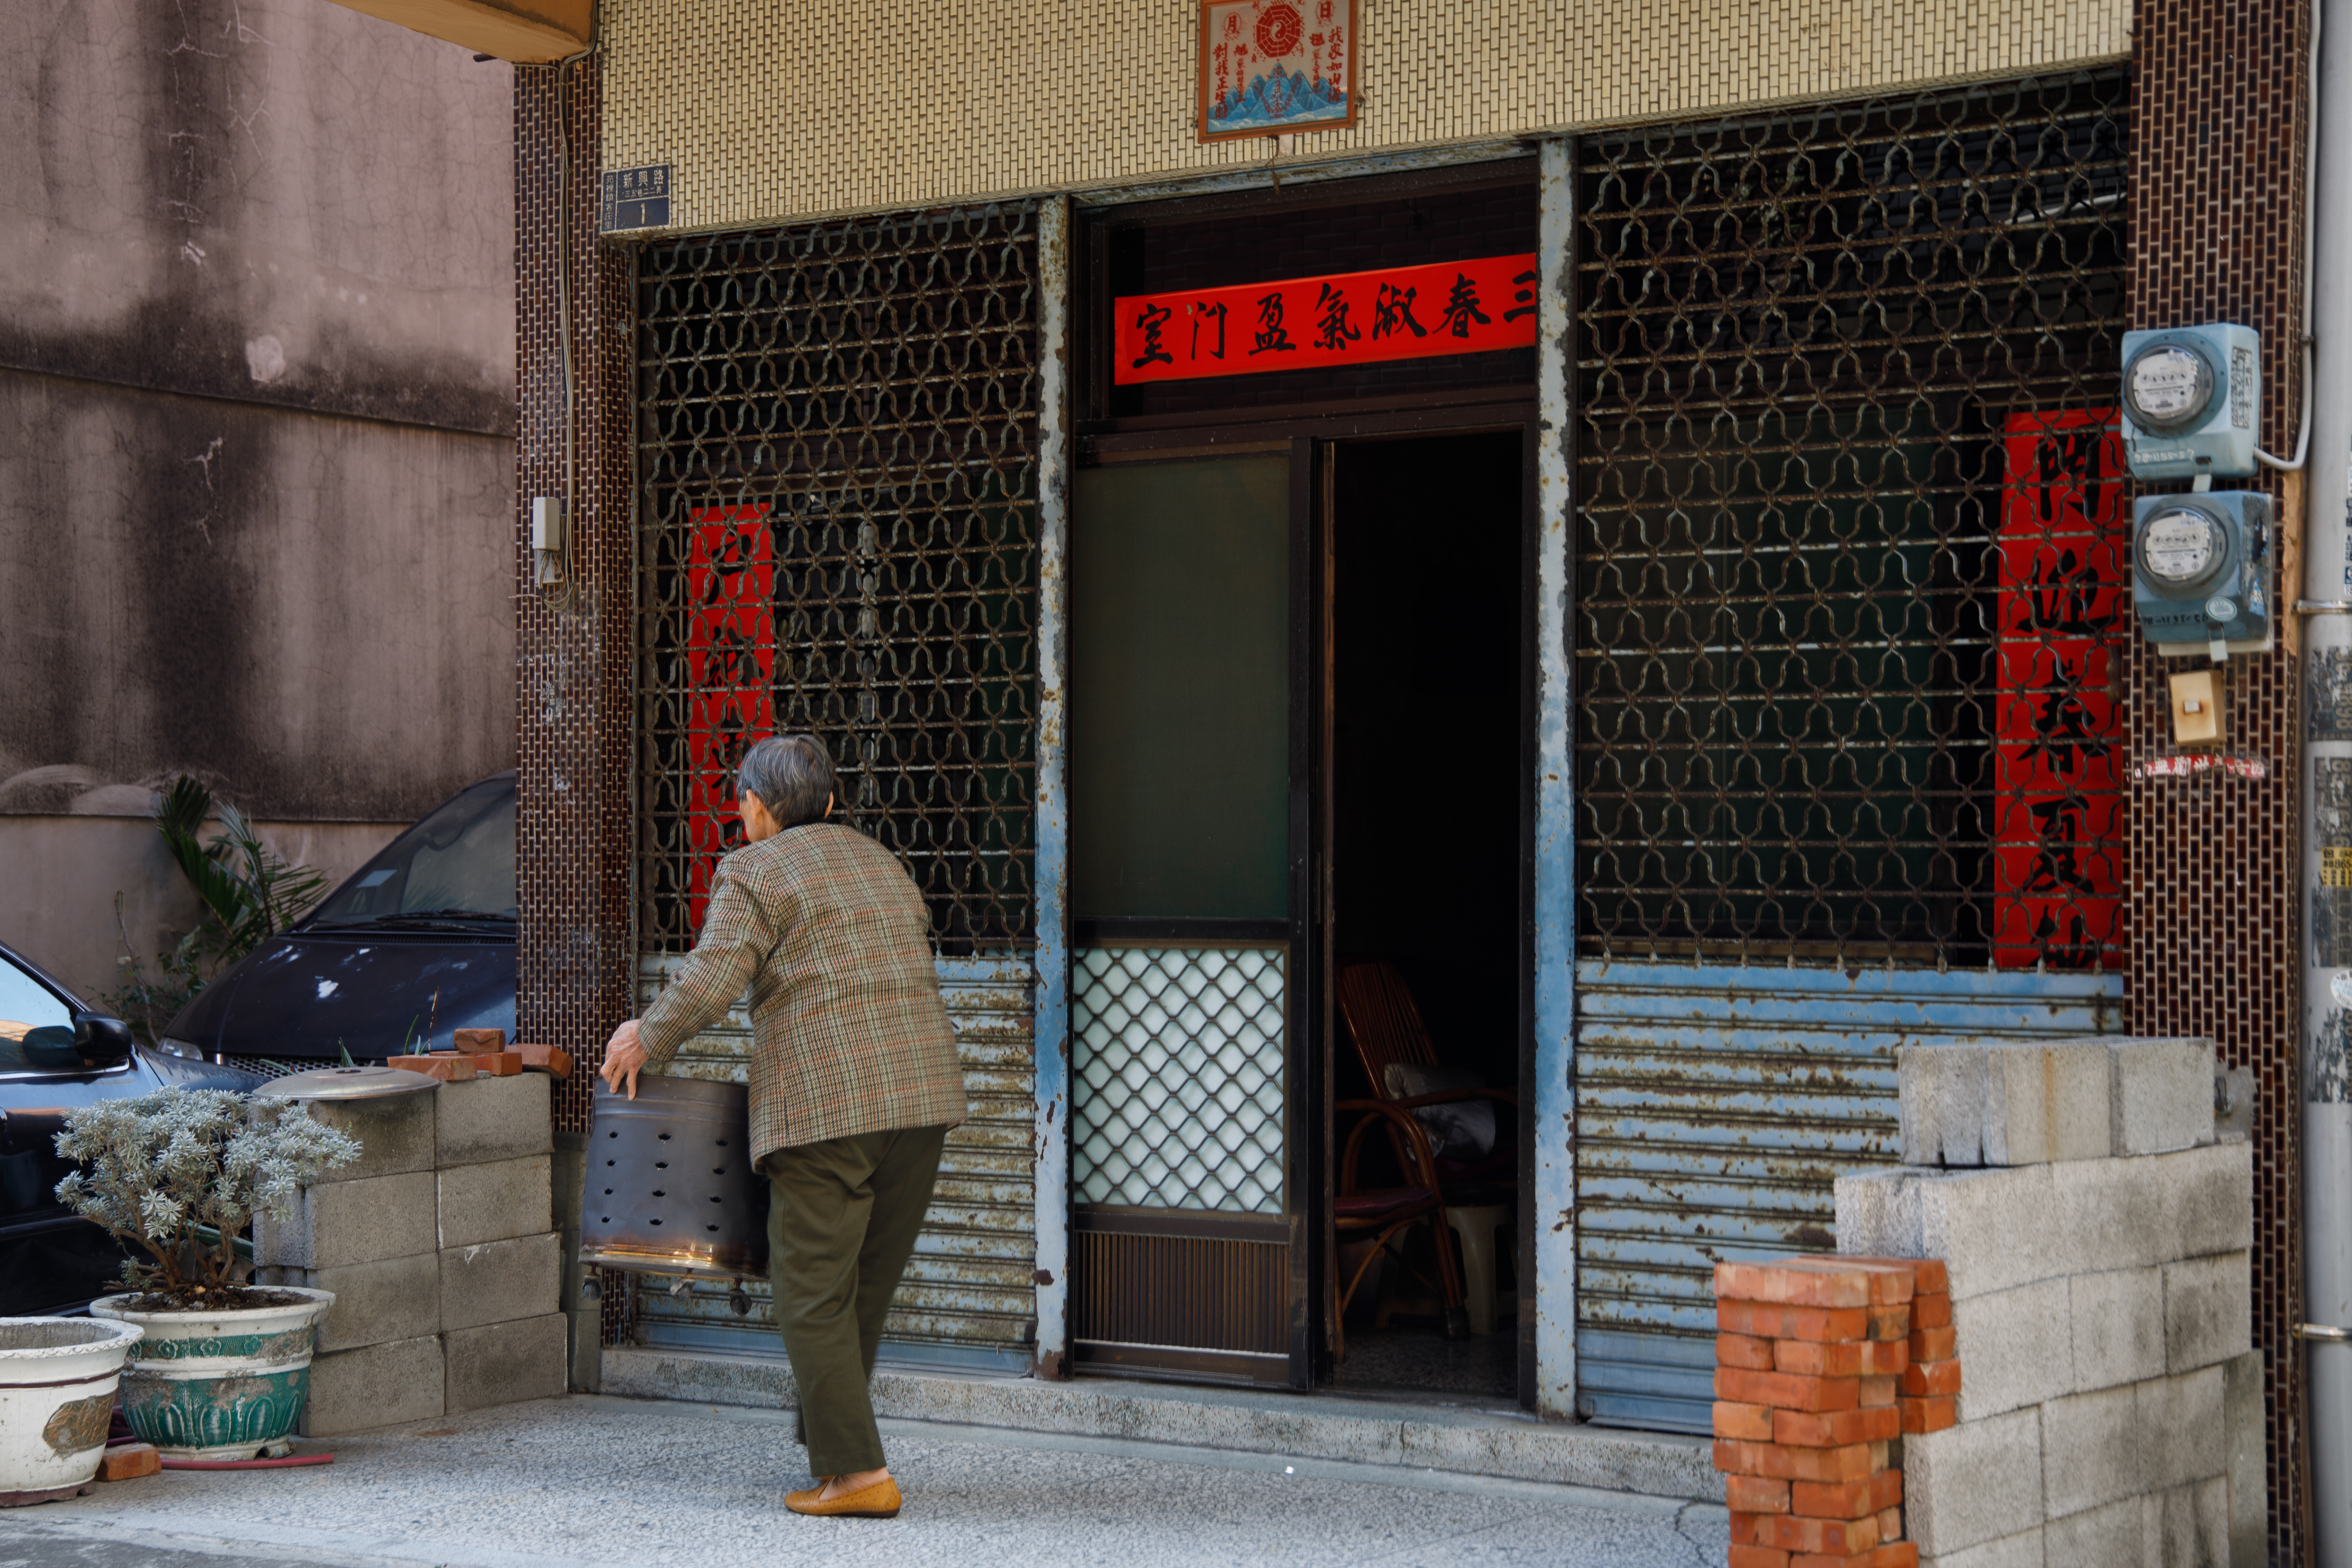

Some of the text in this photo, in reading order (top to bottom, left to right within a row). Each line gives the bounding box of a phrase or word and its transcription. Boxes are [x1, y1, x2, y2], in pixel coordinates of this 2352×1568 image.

[1326, 25, 1343, 103] 我家如山海
[623, 169, 664, 189] 新興路
[604, 175, 615, 229] 苑裡鎮客庄里
[640, 203, 646, 224] 1
